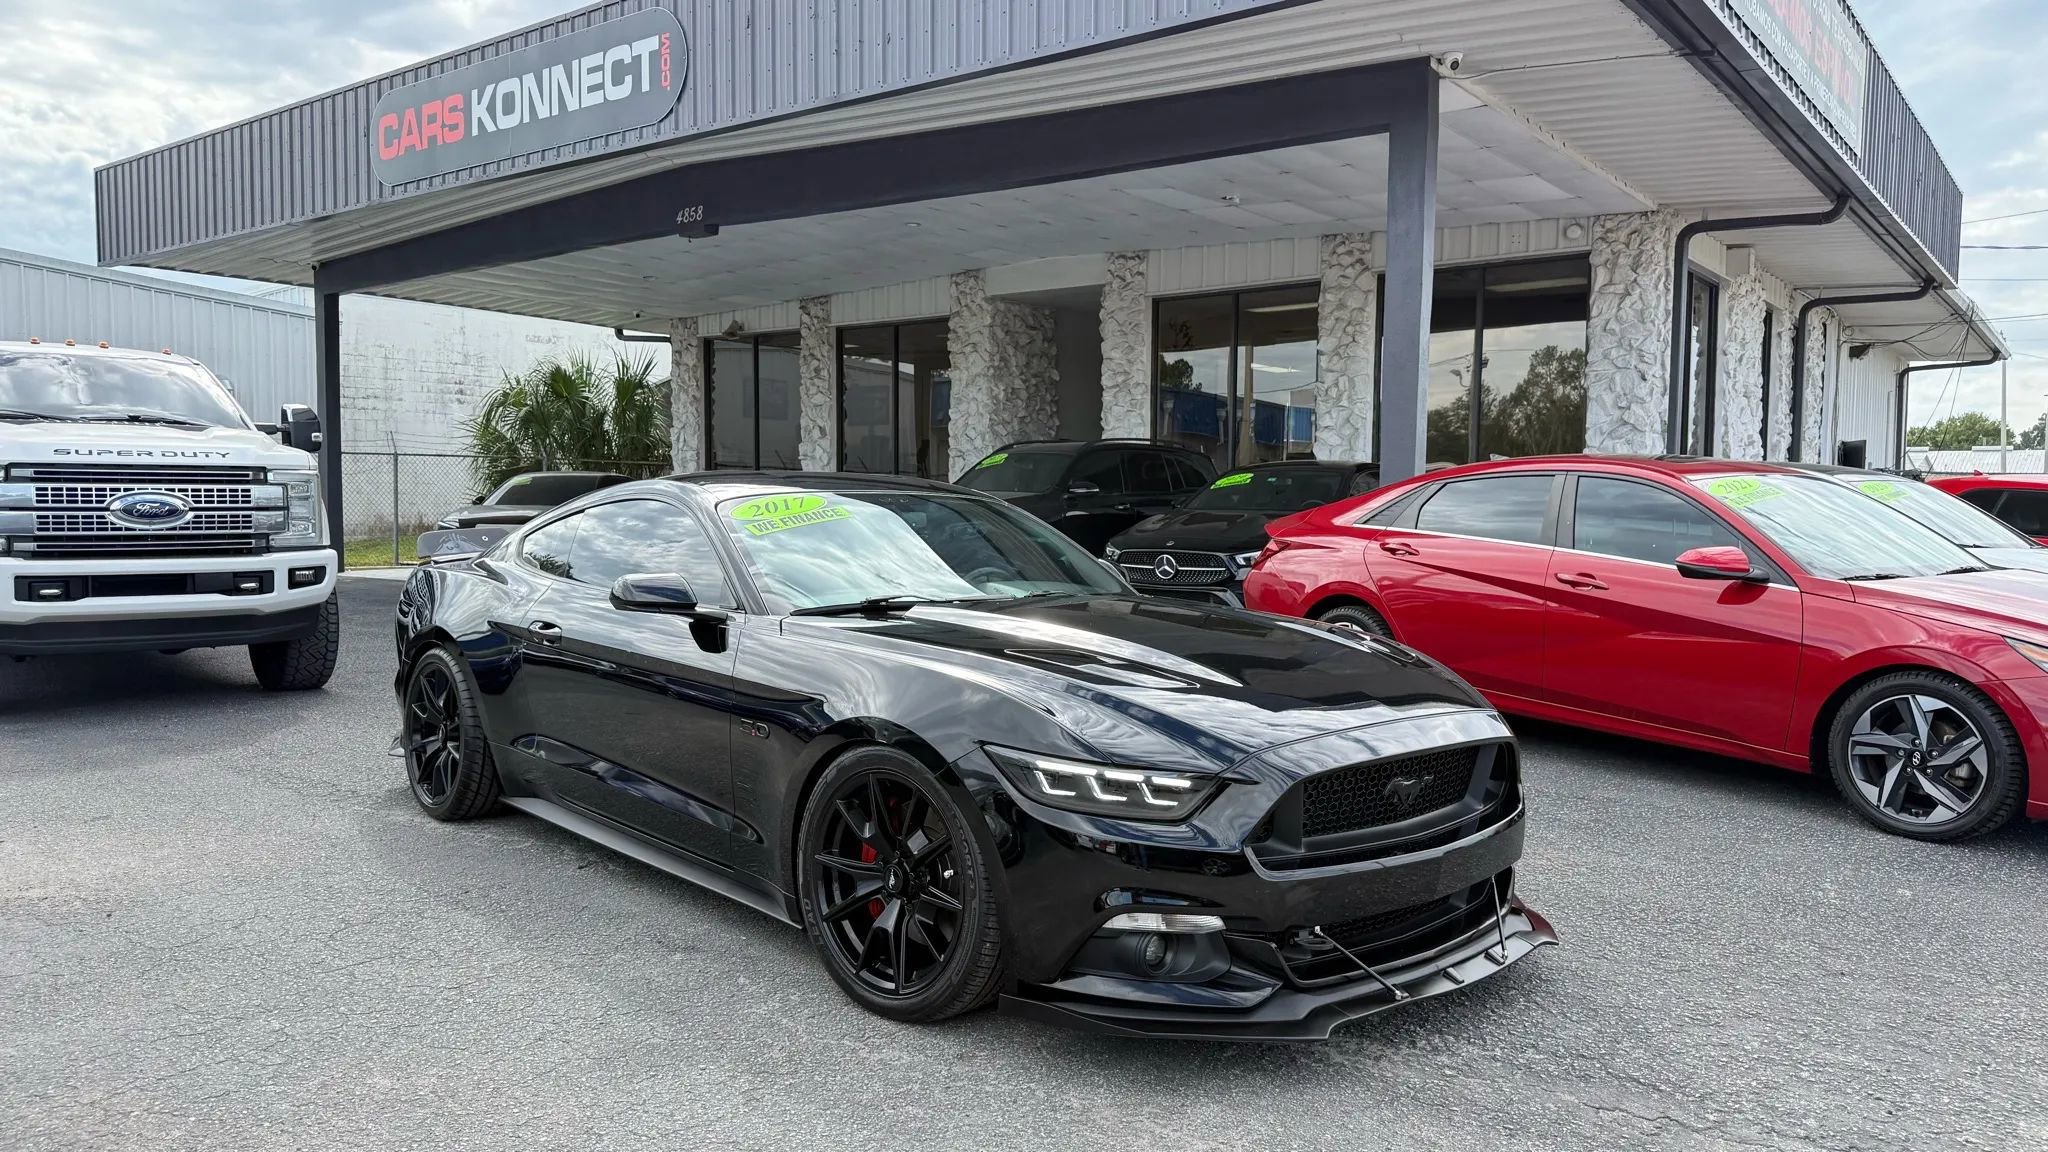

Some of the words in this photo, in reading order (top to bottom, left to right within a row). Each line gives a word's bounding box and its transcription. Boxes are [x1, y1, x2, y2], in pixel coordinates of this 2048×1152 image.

[378, 94, 465, 161] CARS
[471, 35, 660, 137] KONNECT
[676, 205, 704, 225] 4858
[53, 448, 154, 457] SUPER
[161, 450, 230, 459] DUTY
[133, 502, 169, 516] Ford
[748, 496, 805, 518] 2017
[752, 520, 779, 533] WE
[780, 508, 843, 528] FINANCE
